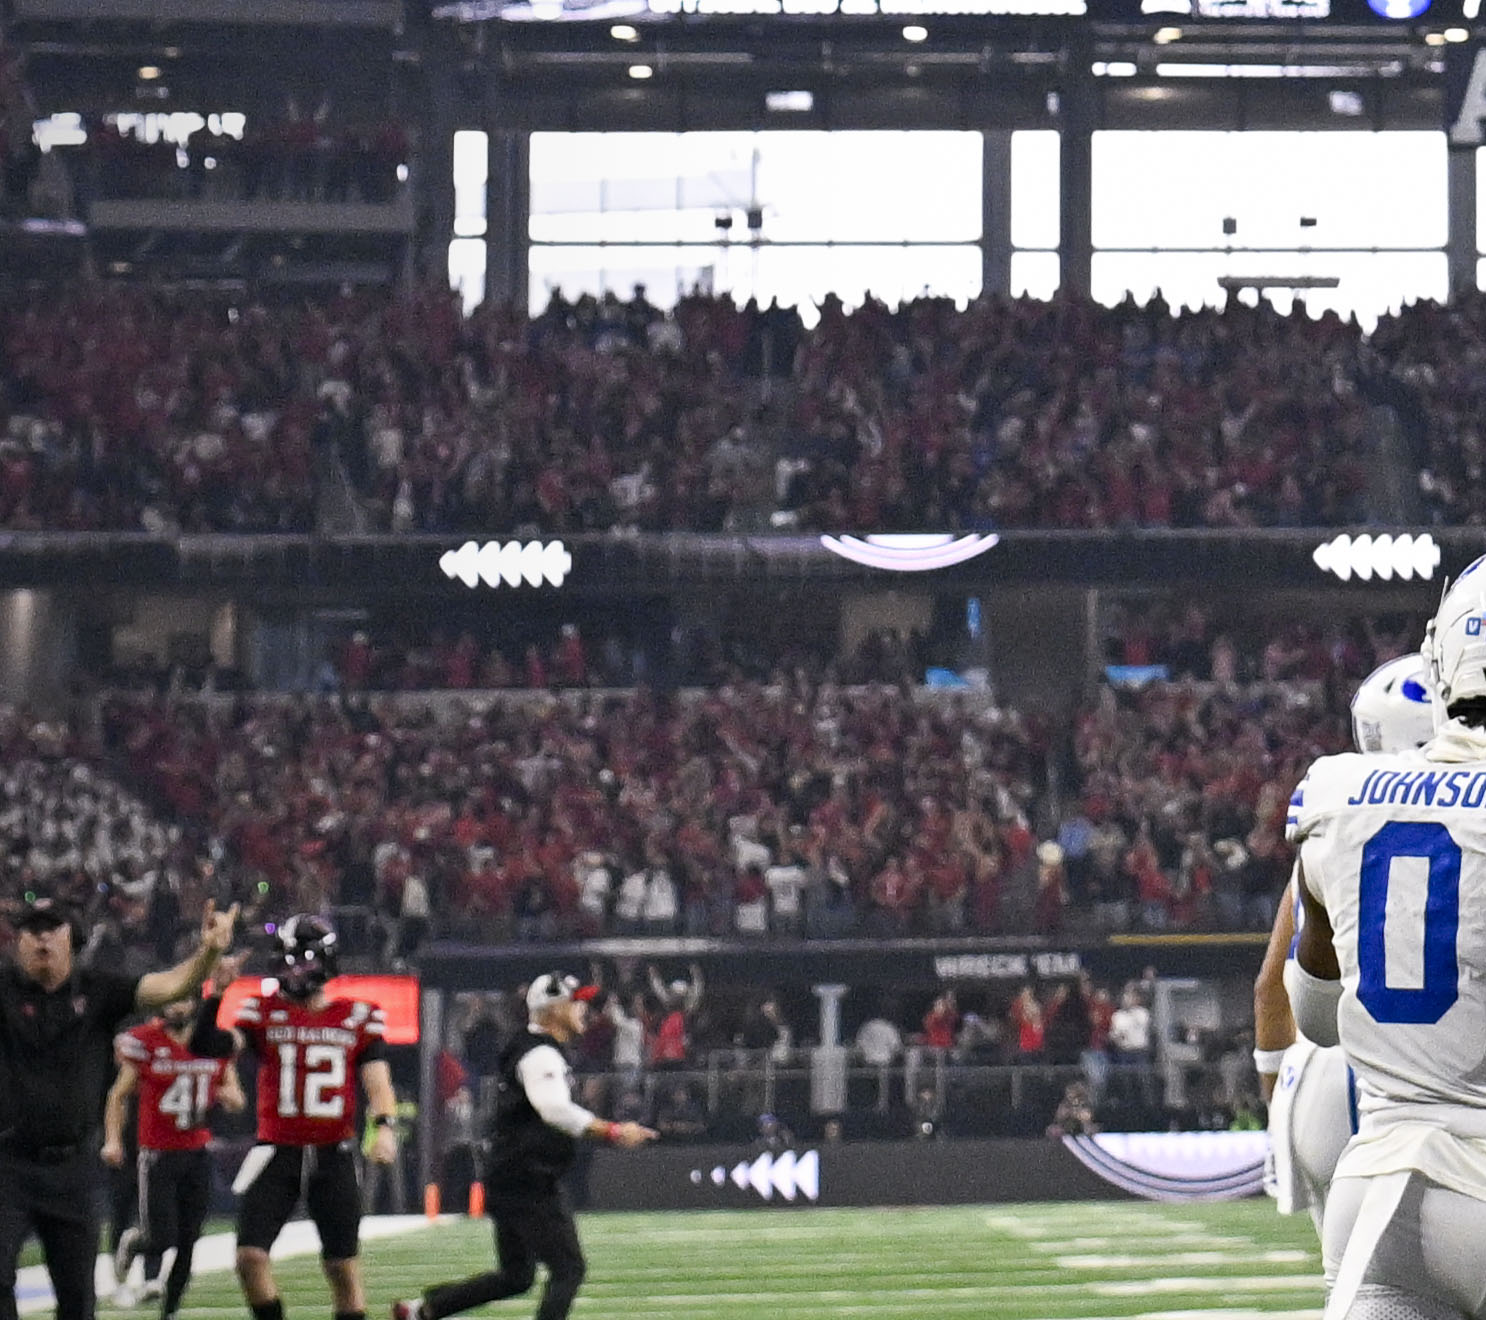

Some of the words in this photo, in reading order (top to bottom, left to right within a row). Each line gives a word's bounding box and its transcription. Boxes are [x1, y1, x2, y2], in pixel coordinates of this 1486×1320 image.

[1356, 820, 1463, 1025] 0
[159, 1073, 212, 1130] 41
[277, 1042, 346, 1119] 12
